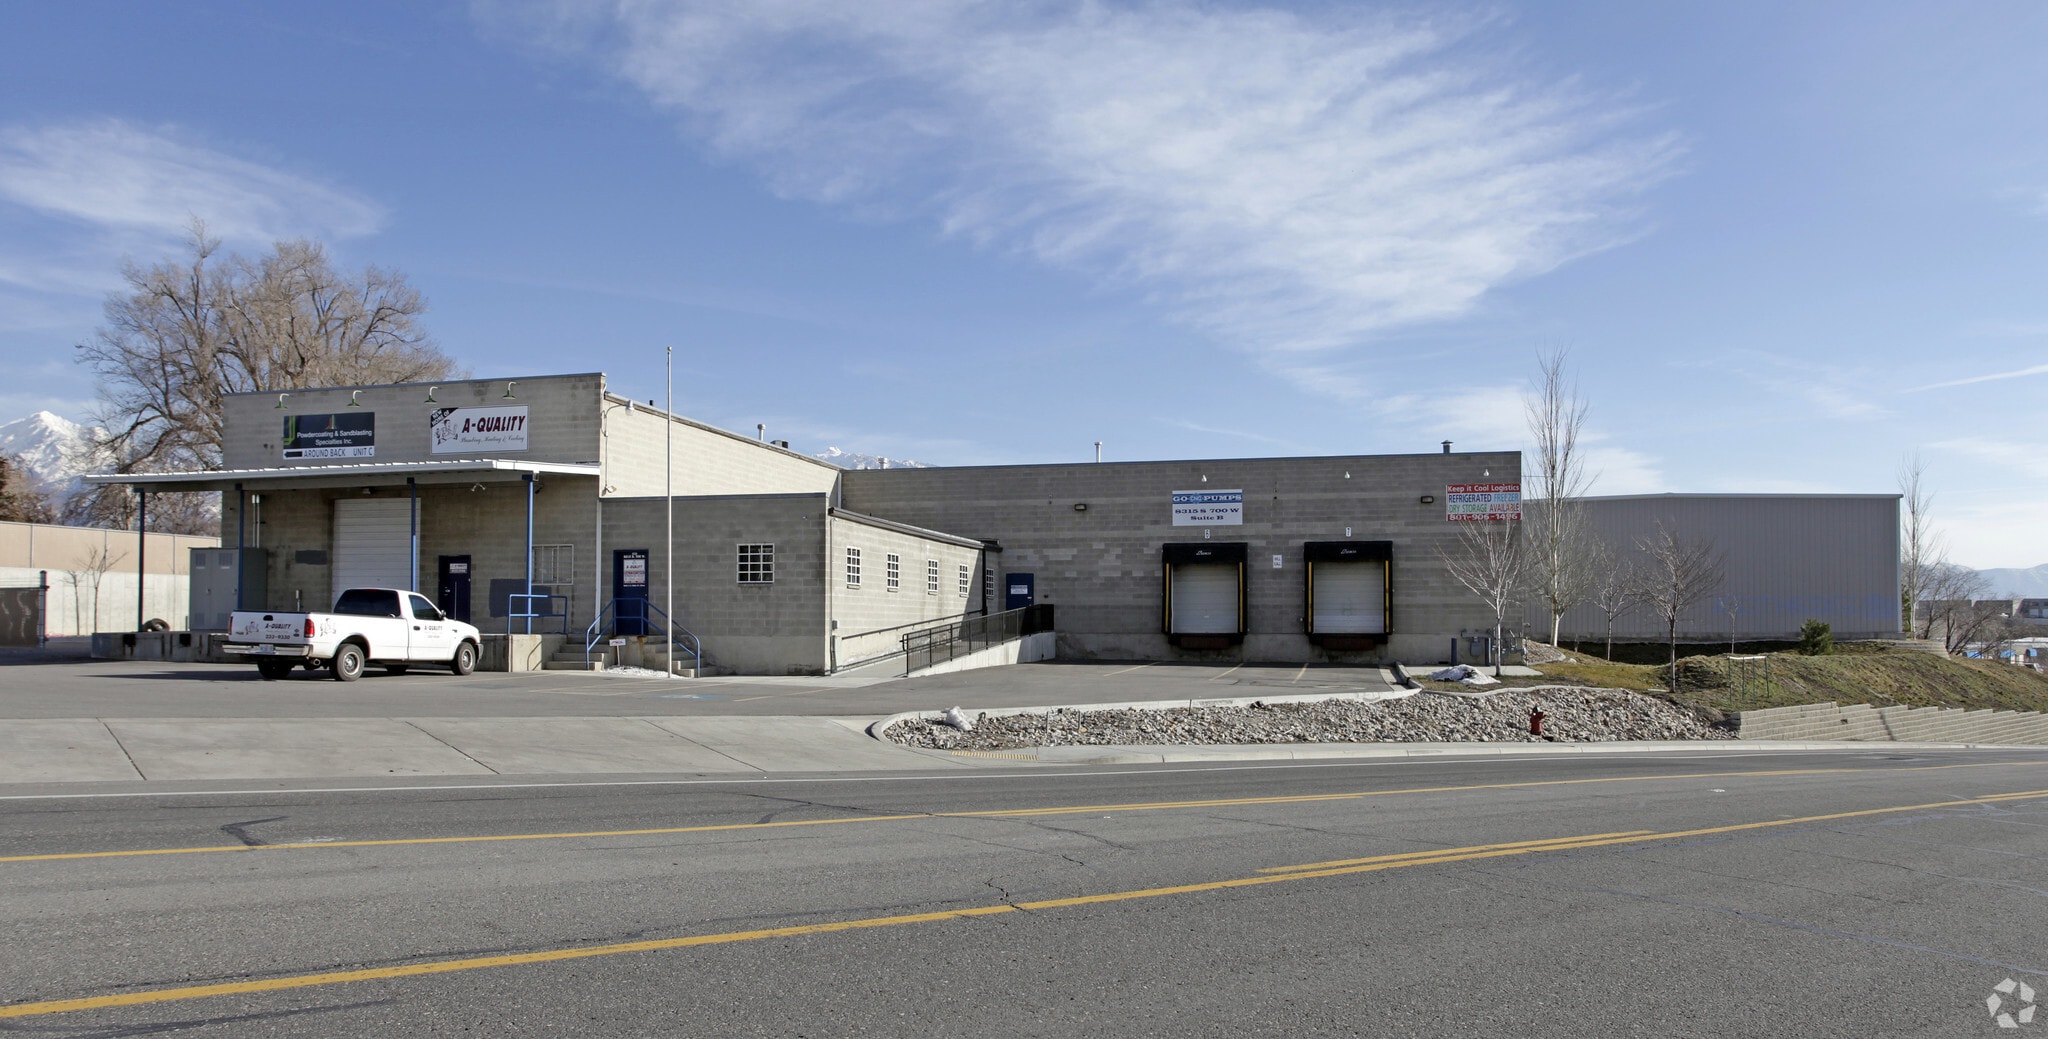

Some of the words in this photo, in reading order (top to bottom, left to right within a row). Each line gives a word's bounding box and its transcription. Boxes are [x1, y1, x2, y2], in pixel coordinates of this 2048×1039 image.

[462, 416, 525, 433] A-QUALITY
[304, 449, 328, 457] AROUND
[1449, 494, 1491, 503] REFRIGERATED
[1494, 493, 1518, 502] FREEZER
[1449, 504, 1460, 513] DRY
[1462, 504, 1487, 512] STORAGE
[1490, 503, 1519, 512] AVAILABLE
